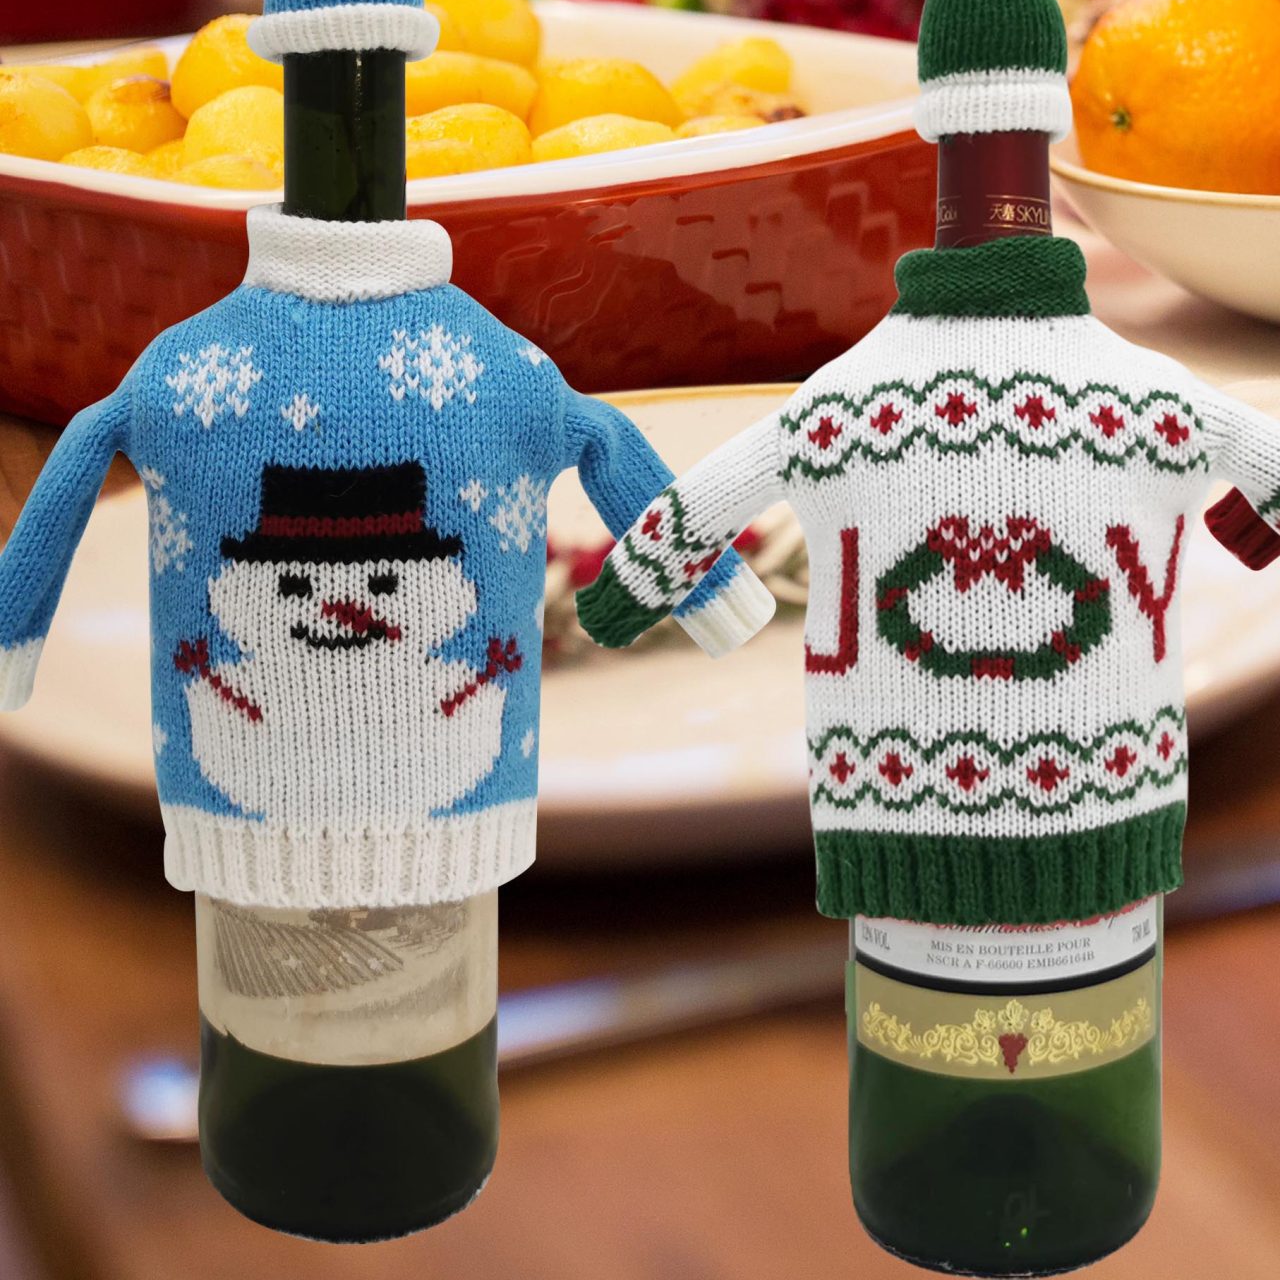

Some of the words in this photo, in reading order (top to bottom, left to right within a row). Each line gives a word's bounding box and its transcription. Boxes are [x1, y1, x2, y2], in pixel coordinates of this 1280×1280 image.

[931, 940, 953, 952] MIS
[957, 943, 975, 955] EN
[978, 943, 1054, 956] BOUTEILLE
[1057, 937, 1092, 952] POUR
[963, 958, 972, 968] A
